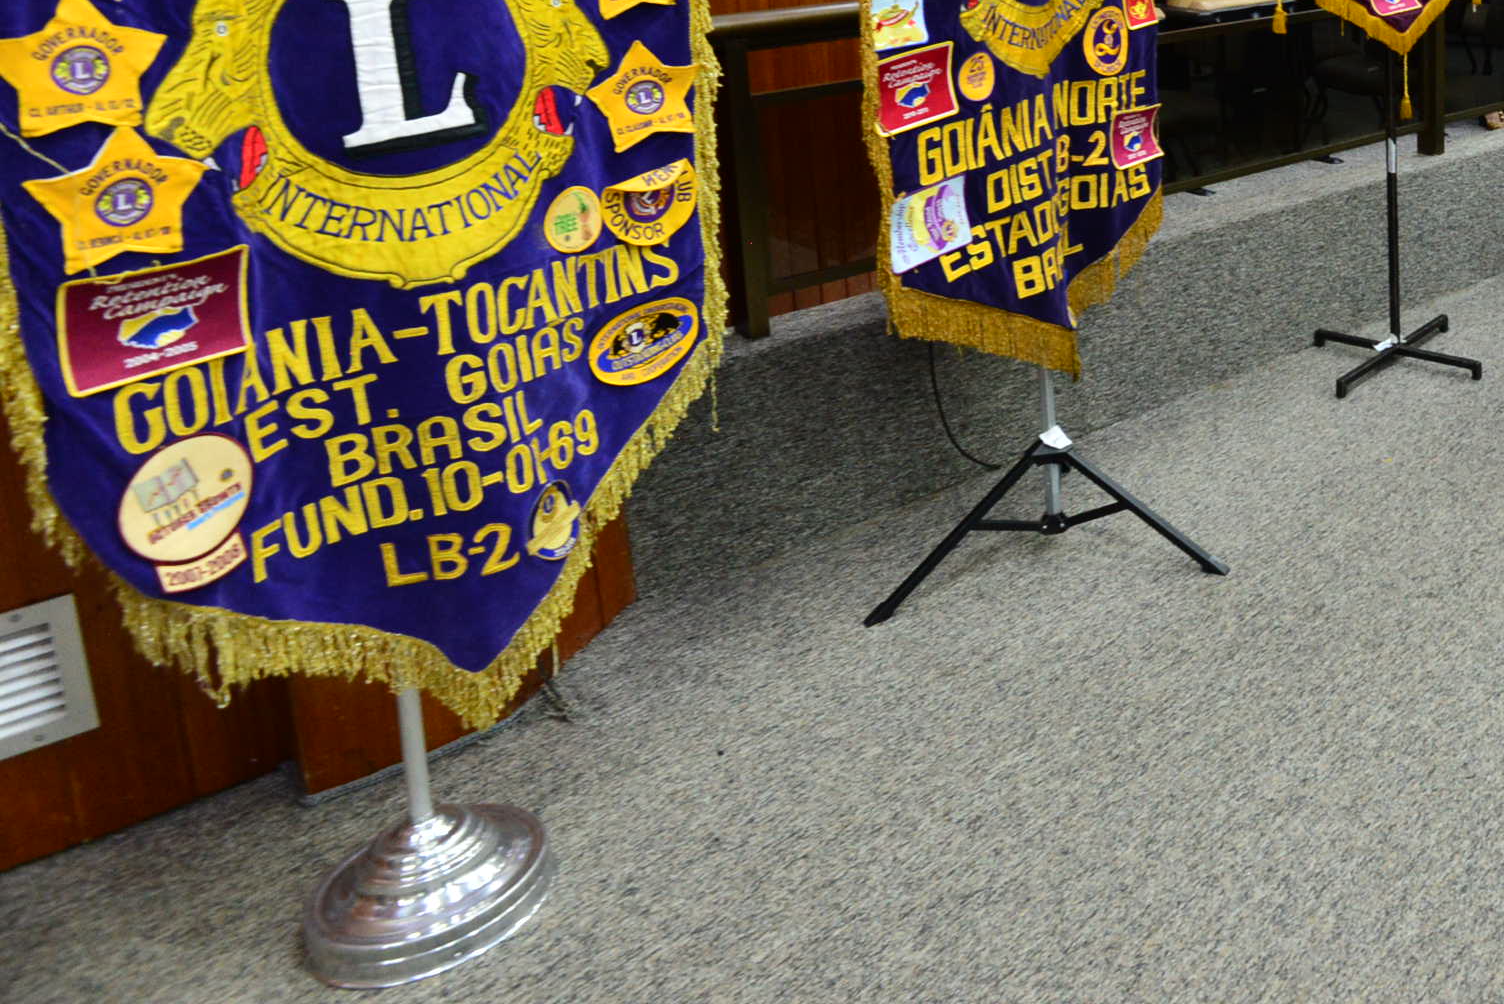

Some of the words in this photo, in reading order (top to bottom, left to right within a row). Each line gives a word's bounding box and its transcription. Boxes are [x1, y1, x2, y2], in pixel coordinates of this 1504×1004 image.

[917, 101, 1053, 186] GOIÂNIA
[1052, 70, 1148, 136] NORTE
[261, 149, 546, 244] INTERNATIONAL
[604, 192, 666, 241] SPONSOR
[245, 375, 399, 463] EST.
[326, 392, 543, 488] BRASIL
[379, 522, 521, 588] LB-2
